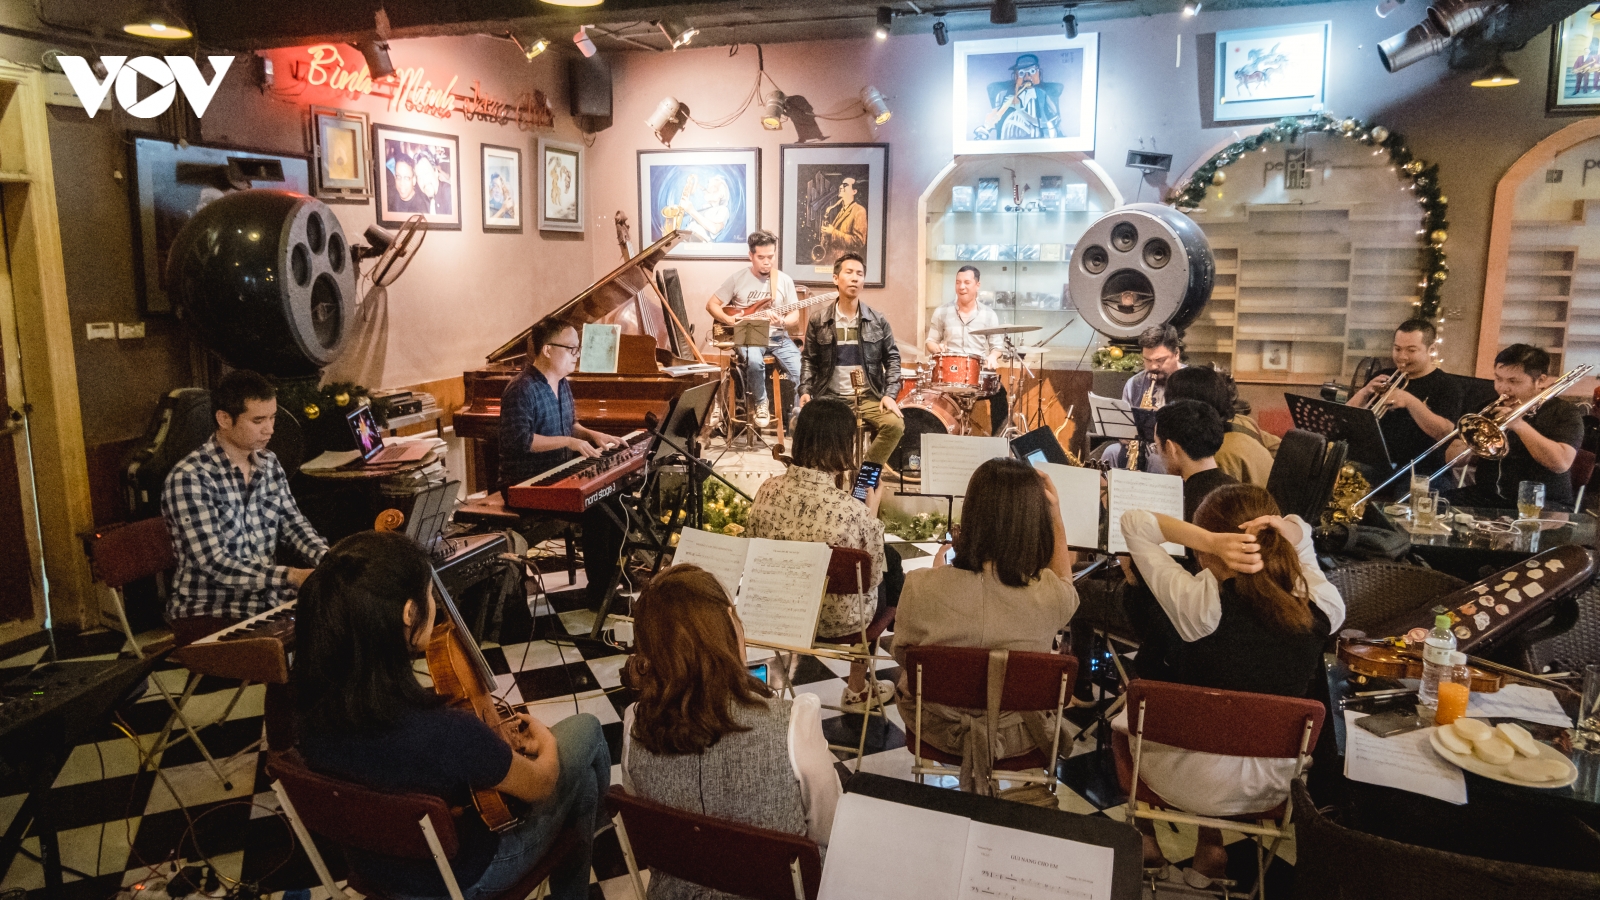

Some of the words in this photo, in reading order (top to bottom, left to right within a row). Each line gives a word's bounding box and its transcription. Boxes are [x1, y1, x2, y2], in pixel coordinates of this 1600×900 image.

[388, 67, 458, 112] Minh
[584, 491, 599, 507] nord
[598, 485, 612, 500] stage
